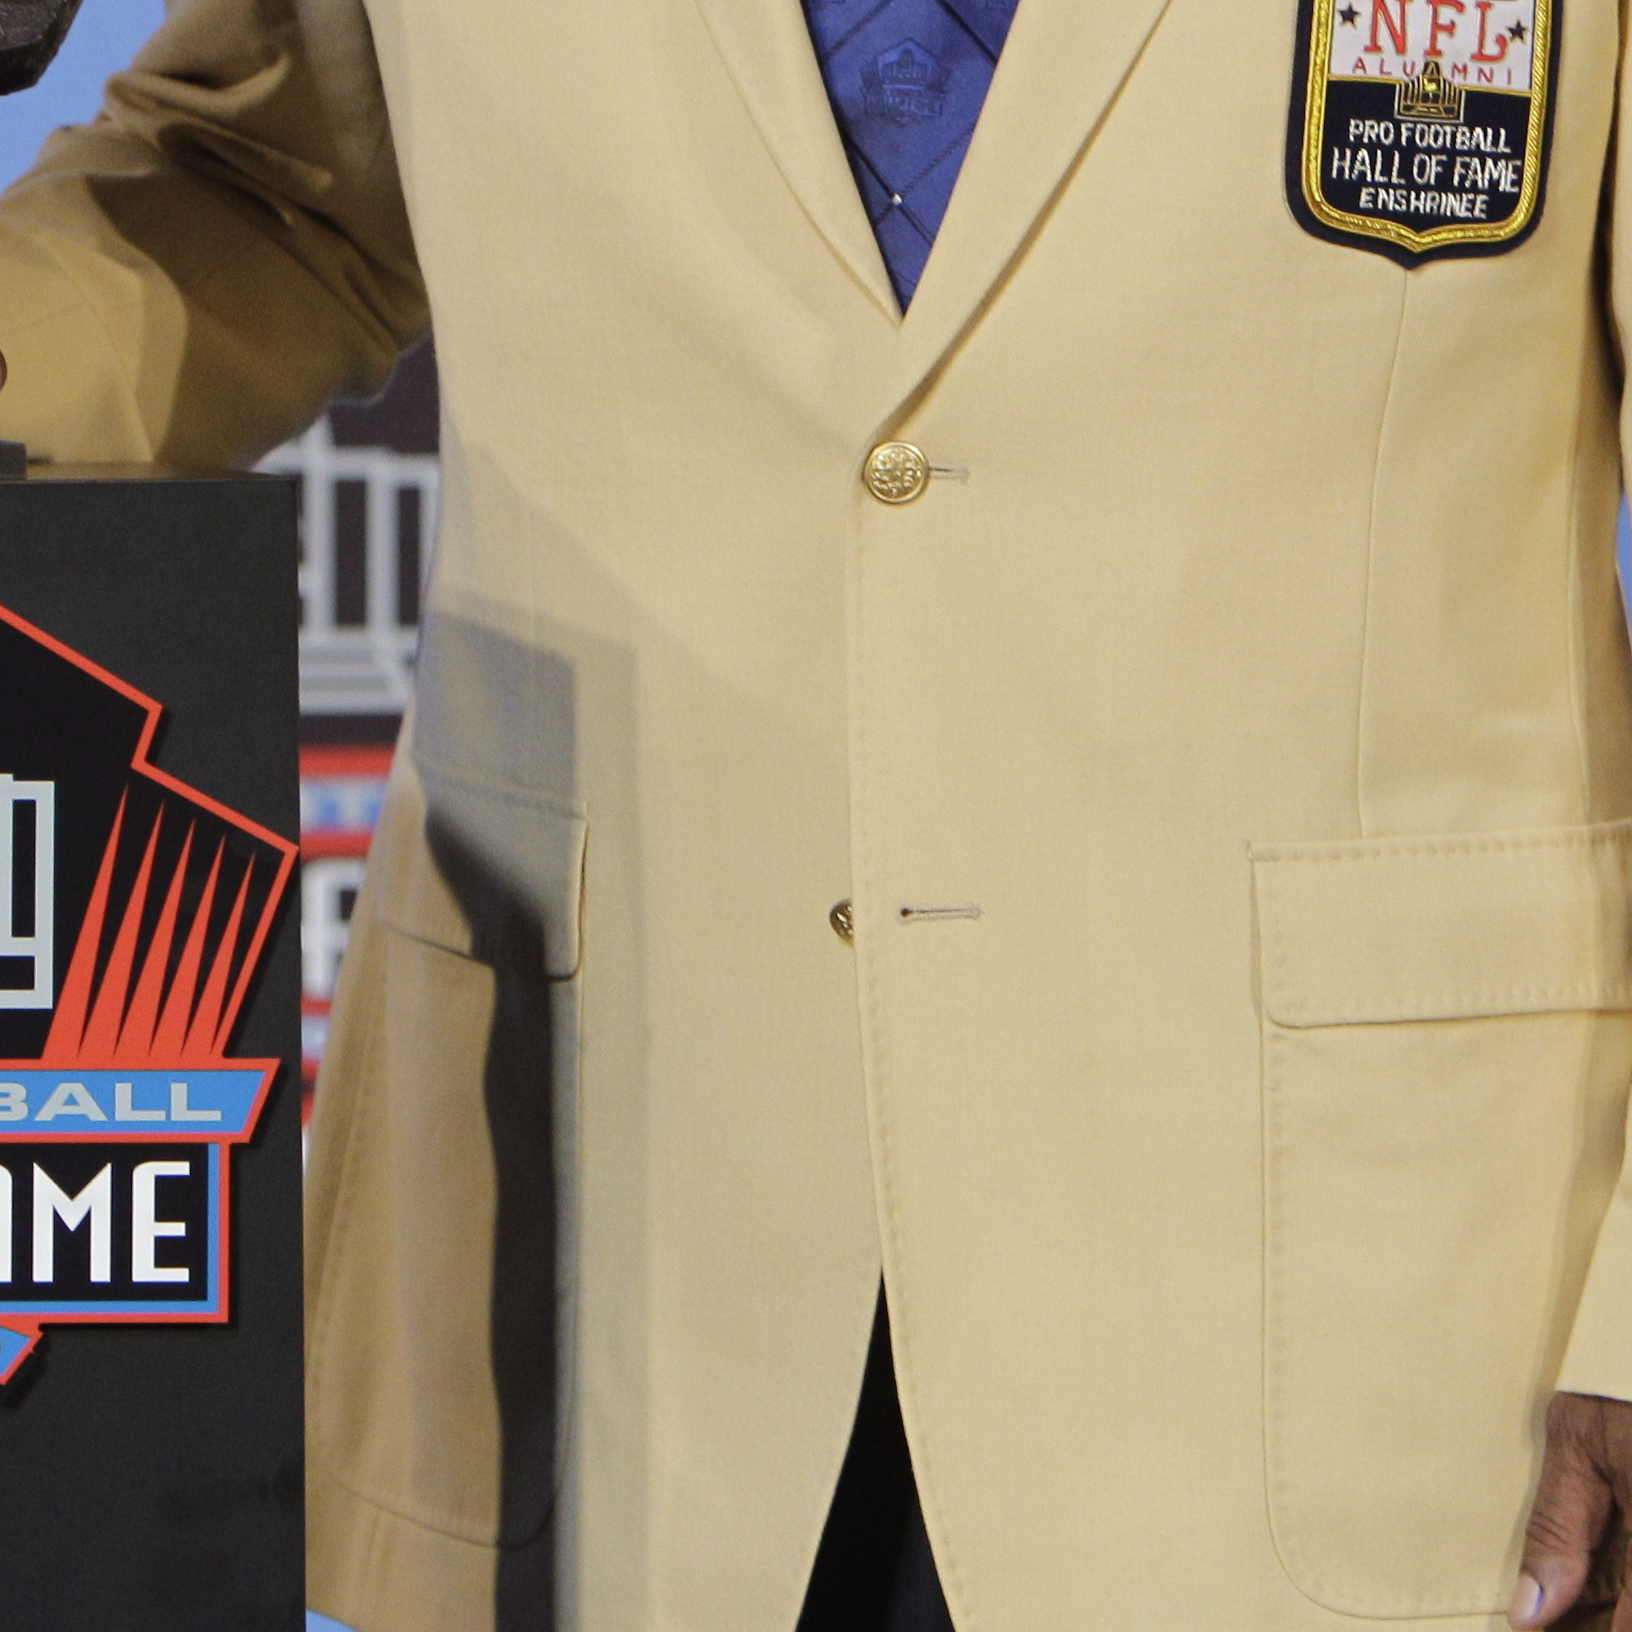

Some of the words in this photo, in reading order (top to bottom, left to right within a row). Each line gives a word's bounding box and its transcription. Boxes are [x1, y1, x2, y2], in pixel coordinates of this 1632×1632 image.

[1348, 118, 1394, 145] PRO
[1400, 121, 1511, 153] FOOTBALL
[1331, 146, 1407, 185] HALL
[1412, 153, 1447, 185] OF
[1452, 155, 1523, 194] FAME
[1358, 188, 1489, 219] ENSHRINEE
